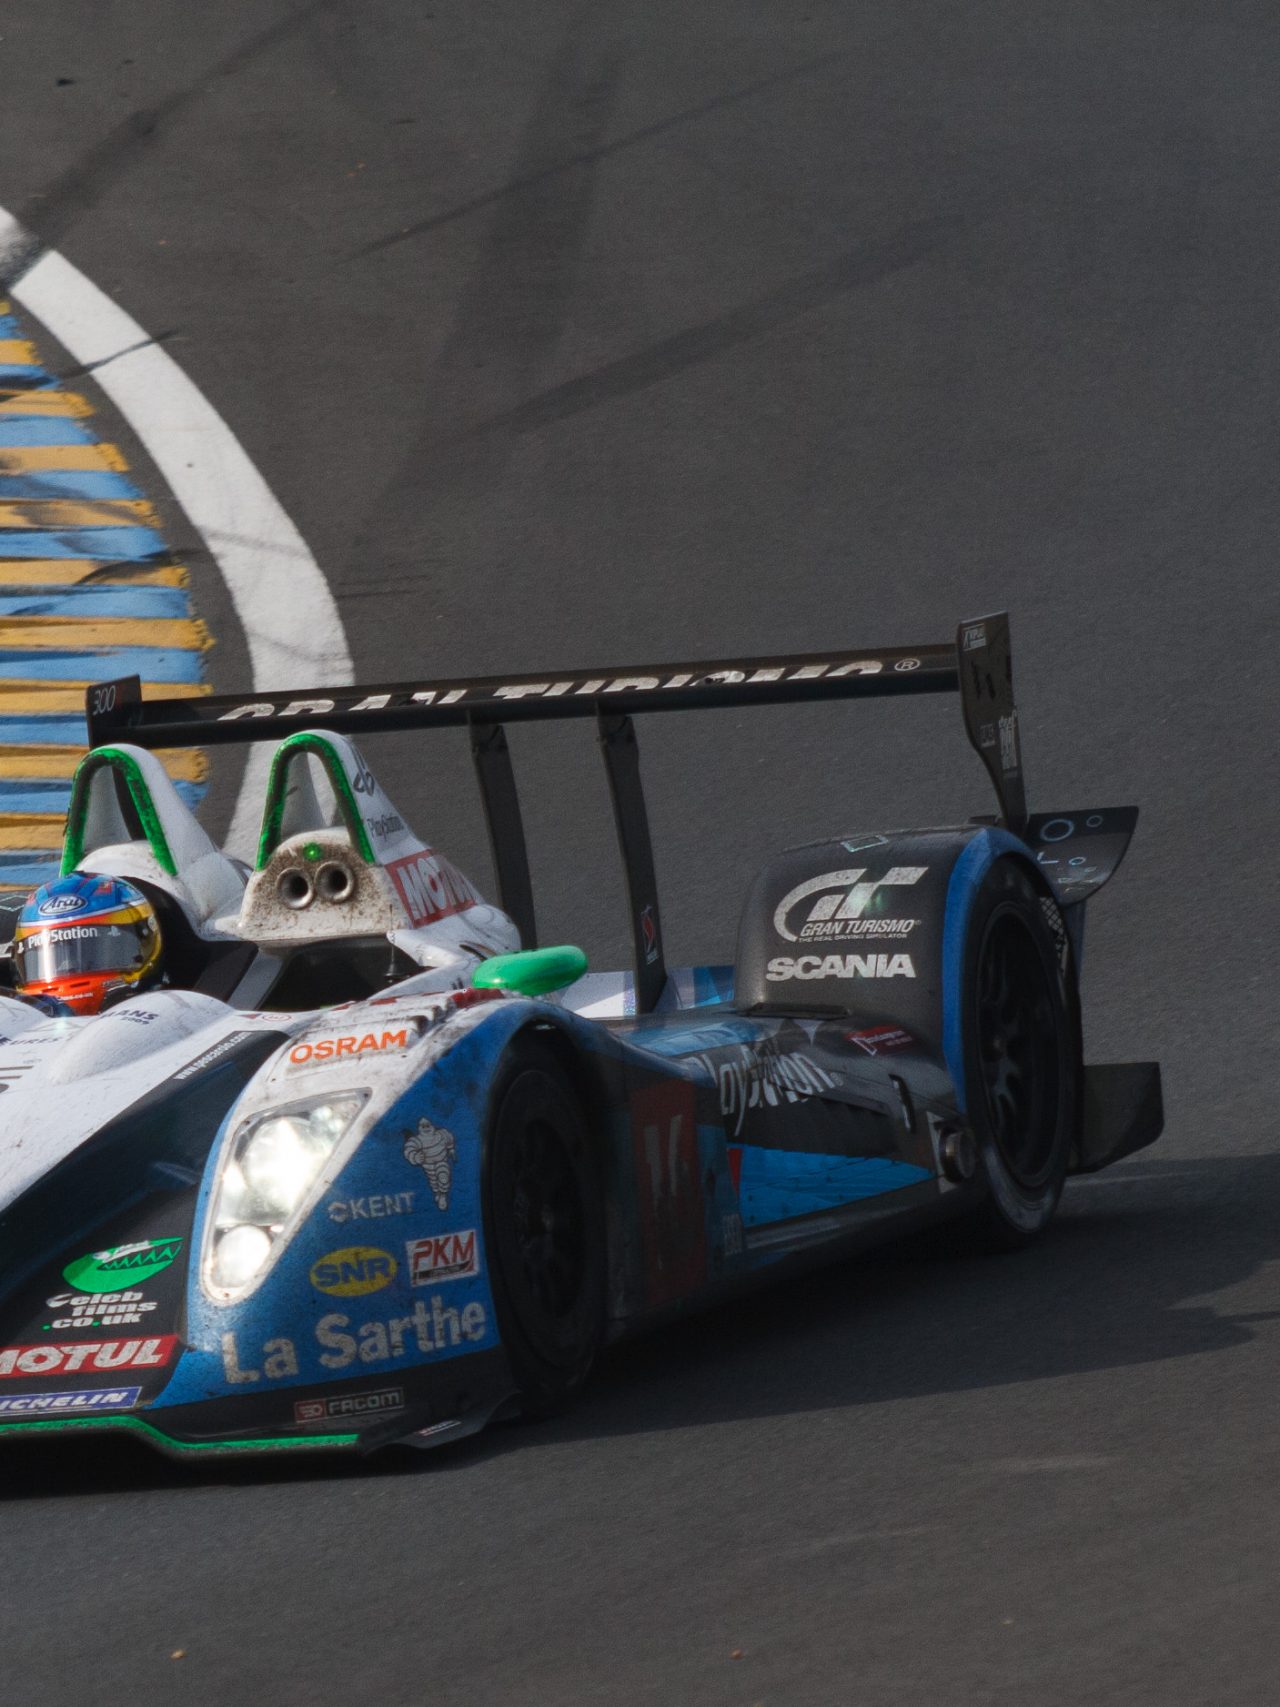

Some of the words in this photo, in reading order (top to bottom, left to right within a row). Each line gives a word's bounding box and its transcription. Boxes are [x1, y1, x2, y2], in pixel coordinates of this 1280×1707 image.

[800, 920, 841, 937] GRAN
[846, 918, 914, 935] TURISMO
[766, 953, 917, 982] SCANIA
[290, 1028, 407, 1065] OSRAM
[412, 1231, 475, 1271] PKM
[316, 1256, 391, 1287] SNR
[42, 1313, 142, 1330] .co.uk
[72, 1302, 158, 1316] films
[221, 1333, 299, 1384] La
[316, 1295, 487, 1370] Sarthe
